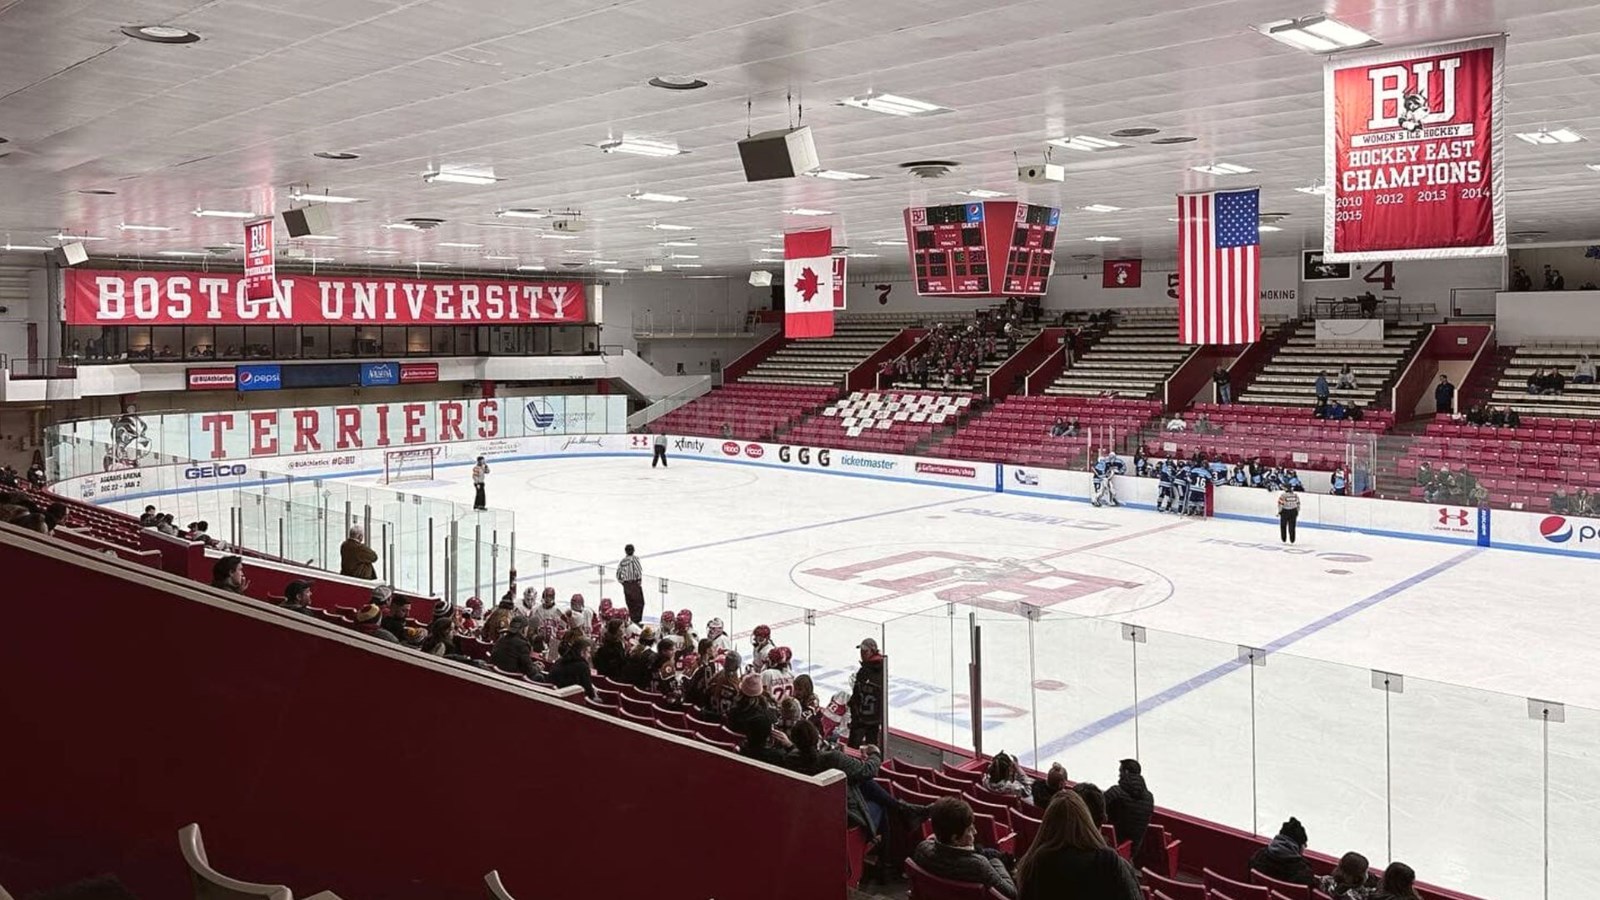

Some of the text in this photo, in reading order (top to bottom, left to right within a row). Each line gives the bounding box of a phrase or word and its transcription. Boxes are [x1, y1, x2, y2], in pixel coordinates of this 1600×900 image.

[1367, 58, 1460, 130] BU
[1362, 126, 1460, 144] WOMEN'S ICE HOCKEY
[1349, 140, 1475, 167] HOCKEY EAST
[1342, 161, 1481, 192] CHAMPIONS
[1336, 187, 1491, 208] 2010 2012 2013 2014
[1336, 211, 1363, 222] 2015
[250, 224, 267, 251] BU
[1363, 260, 1395, 290] 4
[318, 281, 568, 320] UNIVERSITY
[874, 284, 892, 305] 7
[1260, 289, 1295, 300] MOKING
[253, 373, 280, 383] pepsi
[201, 399, 499, 459] TERRIERS
[674, 437, 704, 453] xfinity
[288, 460, 329, 469] @BUAthletics
[778, 445, 831, 467] G G G
[840, 455, 895, 470] ticketmaster
[184, 464, 247, 480] GEICO
[1195, 477, 1205, 490] 16
